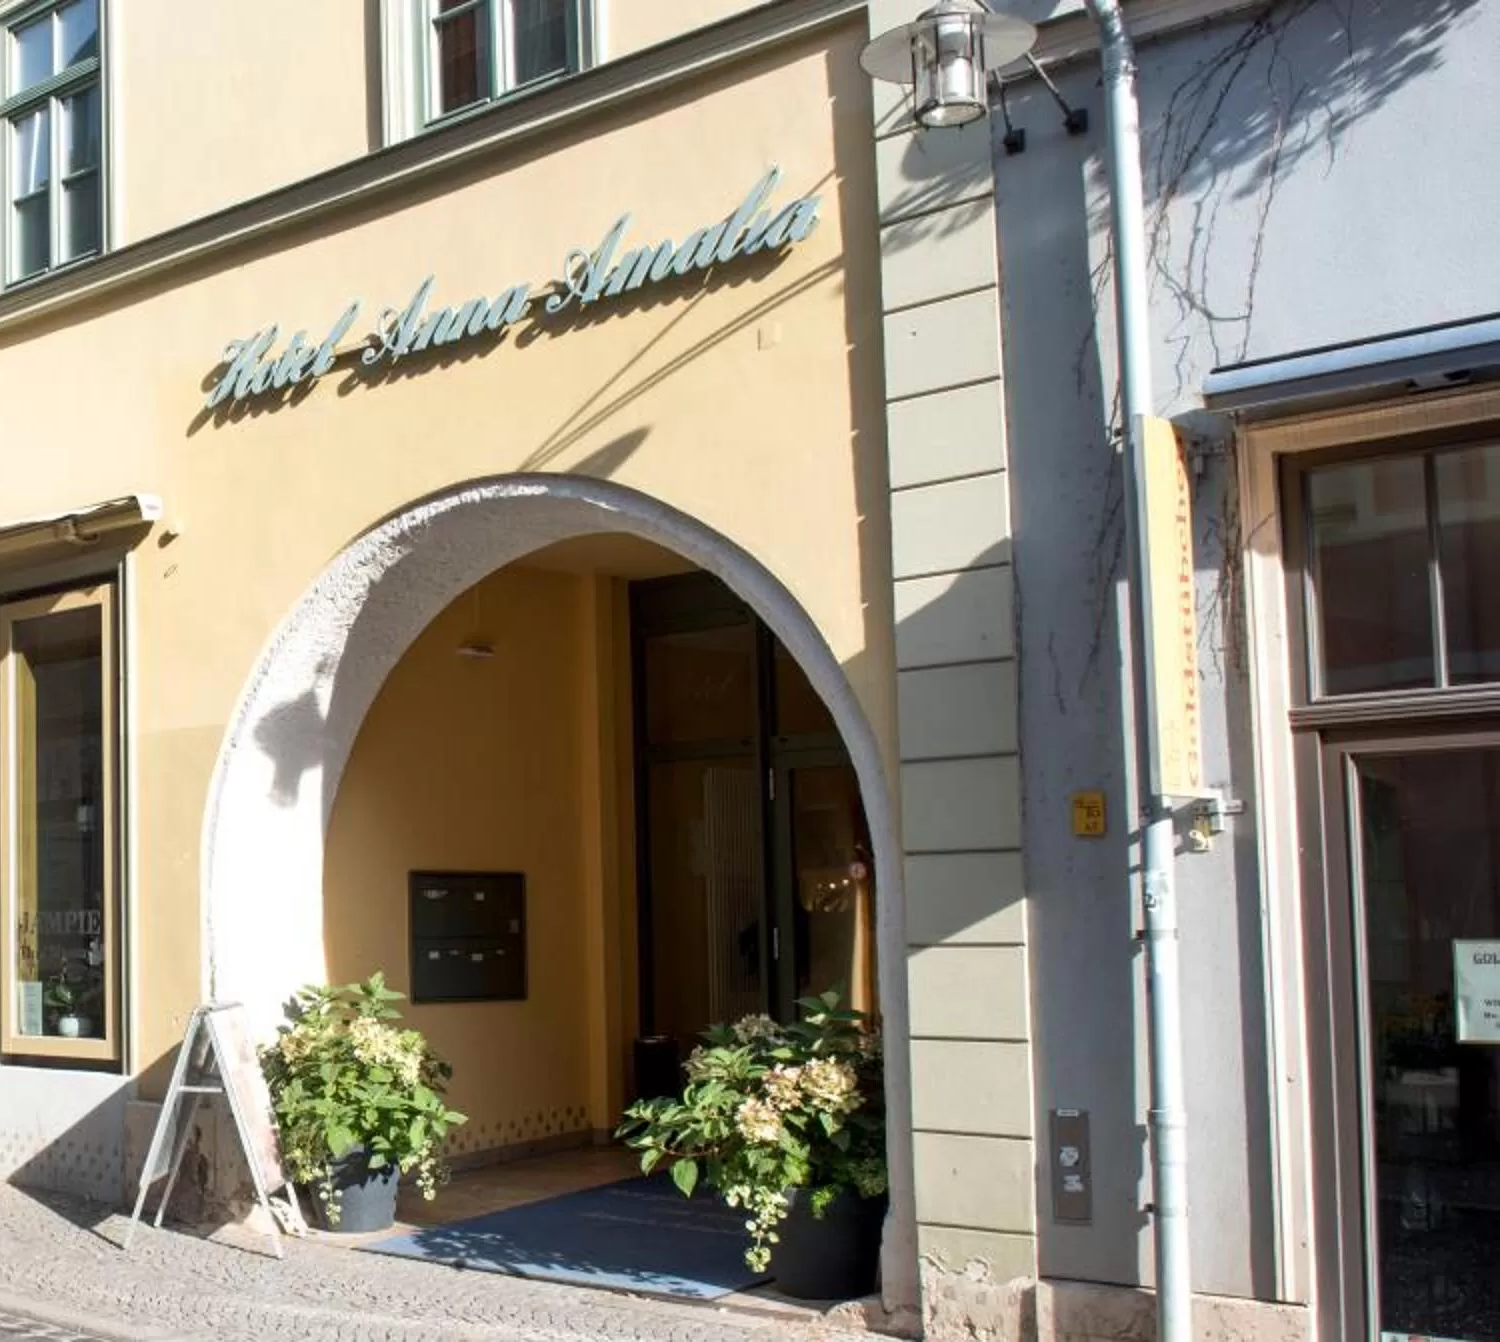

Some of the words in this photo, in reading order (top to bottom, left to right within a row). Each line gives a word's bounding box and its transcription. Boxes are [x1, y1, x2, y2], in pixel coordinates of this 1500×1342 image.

[205, 297, 361, 411] Hotel
[361, 273, 532, 366] Anna
[545, 164, 822, 312] Amalia
